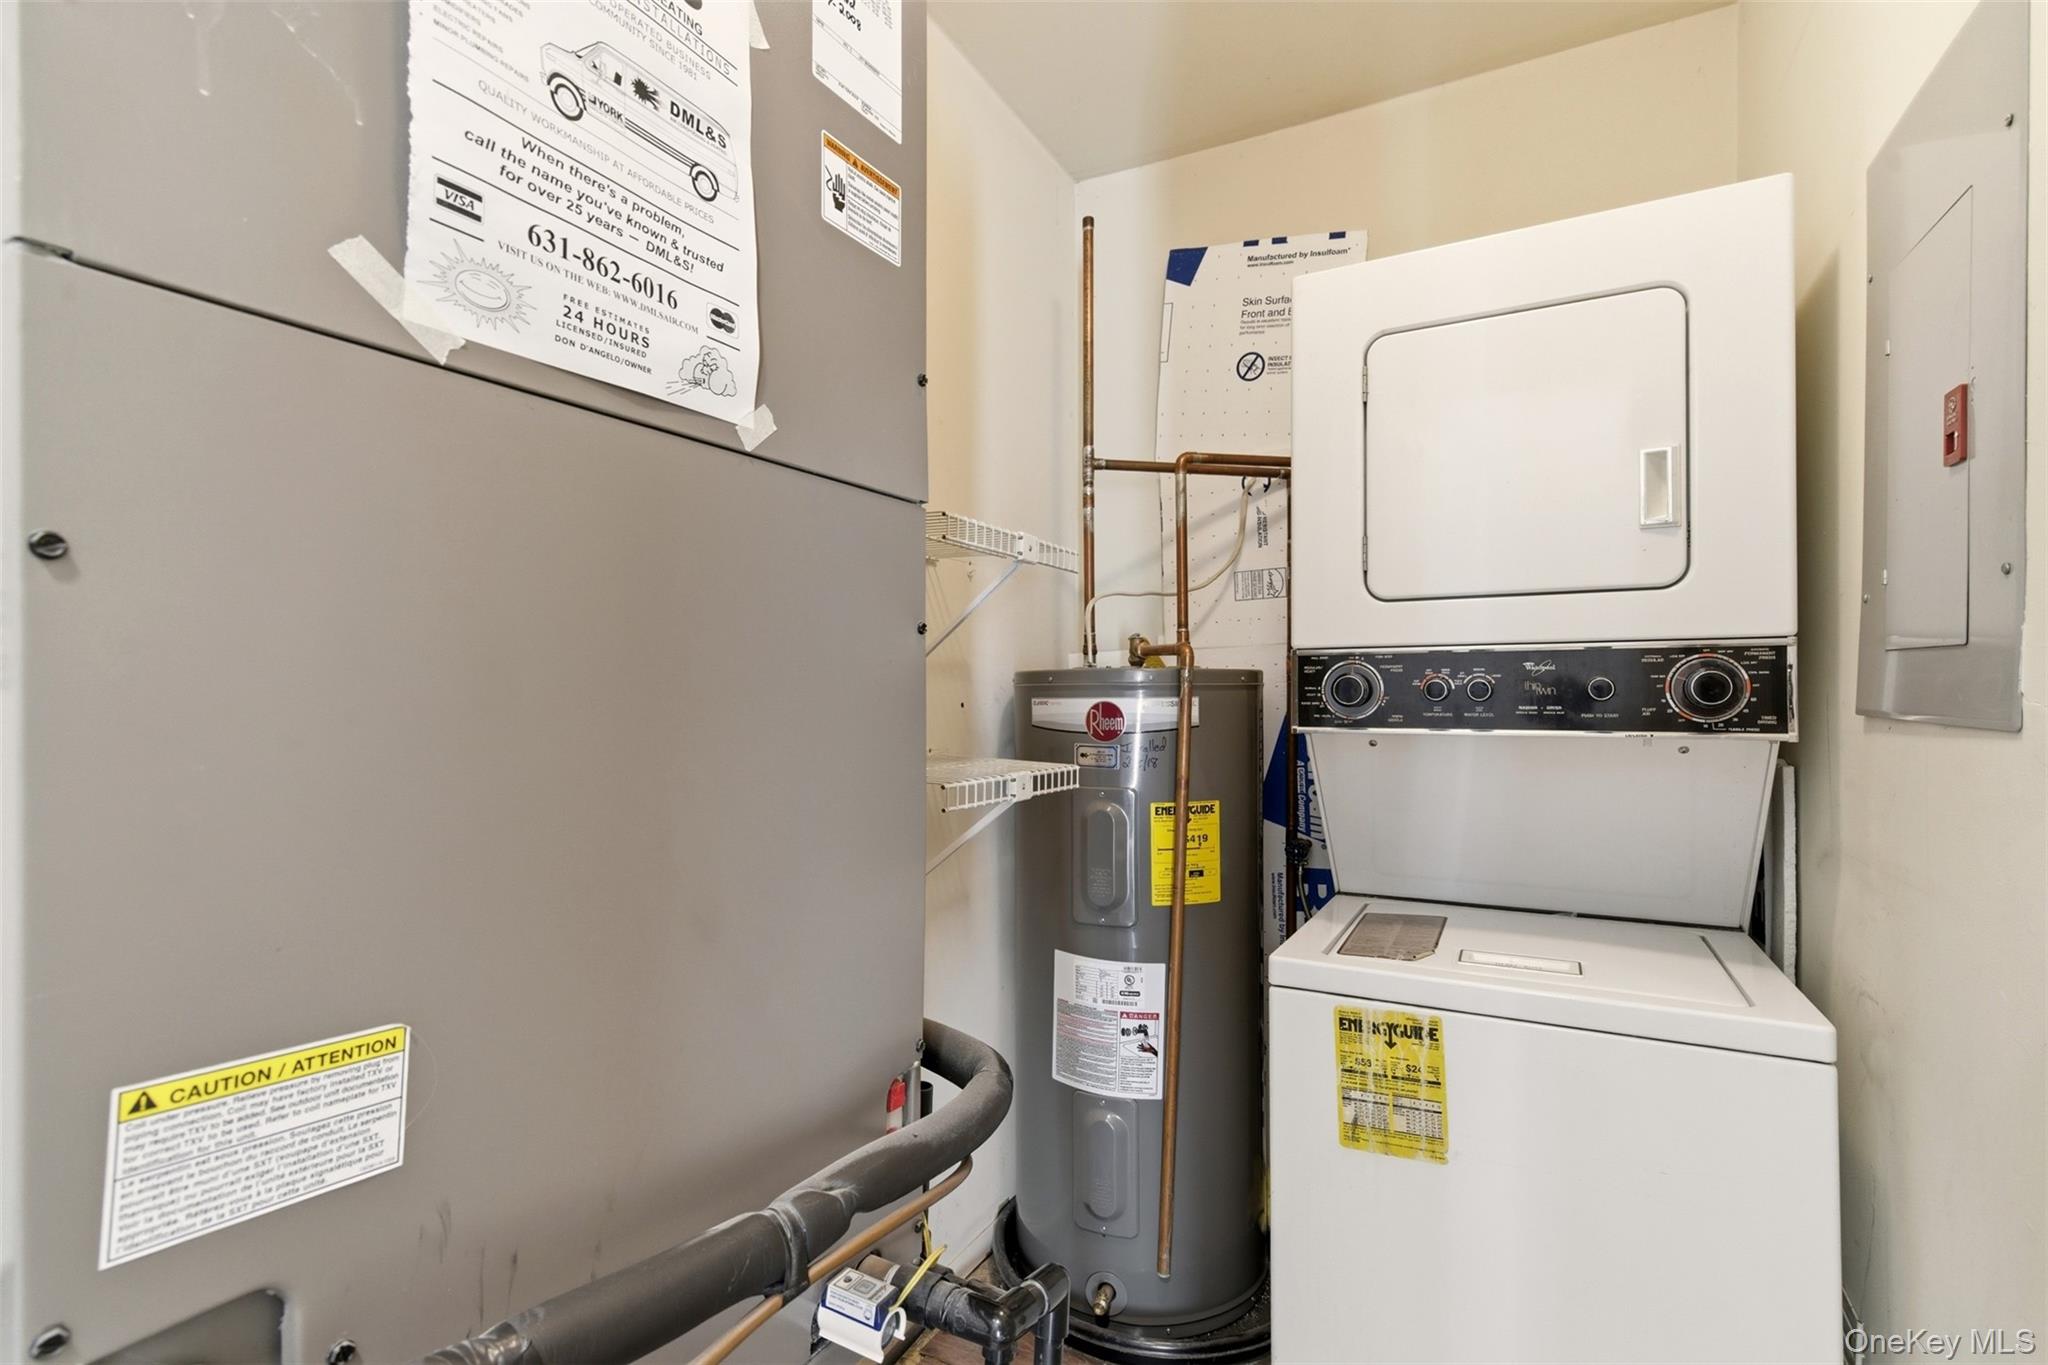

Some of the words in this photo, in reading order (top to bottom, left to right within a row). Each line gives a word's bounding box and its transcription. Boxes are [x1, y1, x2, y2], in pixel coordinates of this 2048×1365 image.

[649, 39, 677, 65] SINCE
[679, 61, 697, 81] 1981
[666, 41, 711, 80] BUSINESS
[599, 100, 624, 123] YORK
[670, 100, 728, 149] DML&S
[478, 79, 528, 115] QUALITY
[531, 112, 611, 164] WORKMANSHIP
[612, 159, 625, 173] AT
[627, 168, 682, 209] AFFORDABLE
[684, 200, 716, 225] PRICES
[444, 188, 476, 211] VISA
[464, 130, 496, 153] call
[500, 146, 527, 169] the
[531, 164, 574, 194] name
[576, 190, 623, 220] you've
[626, 214, 668, 245] known
[670, 238, 680, 250] &
[682, 244, 725, 273] trusted
[521, 137, 565, 171] When
[568, 164, 617, 199] there's
[620, 193, 629, 205] a
[631, 203, 686, 239] problem,
[499, 163, 525, 185] for
[527, 180, 563, 204] over
[565, 199, 583, 216] 25
[586, 211, 625, 239] years
[645, 240, 696, 274] DML&S!
[497, 239, 528, 261] VISIT
[530, 255, 545, 268] US
[545, 261, 561, 274] ON
[562, 268, 585, 285] THE
[586, 278, 611, 295] WEB:
[527, 223, 679, 310] 631-862-6016
[1247, 251, 1298, 262] Manufactured
[1299, 250, 1309, 259] by
[563, 293, 589, 310] FREE
[594, 305, 651, 335] ESTIMATES
[1241, 309, 1266, 319] Front
[1267, 308, 1286, 317] and
[1242, 297, 1263, 307] Skin
[555, 319, 648, 359] LICENSED/INSURED
[562, 305, 584, 323] 24
[593, 318, 651, 349] HOURS
[554, 334, 576, 348] DON
[579, 341, 653, 375] D'ANGELO/OWNER
[1089, 703, 1124, 737] Rheem
[1155, 804, 1215, 816] ENEGUIDE
[1297, 794, 1307, 833] Company
[1276, 872, 1286, 923] Manufactured
[1278, 923, 1286, 934] by
[170, 1066, 271, 1105] CAUTION
[292, 1036, 396, 1074] ATTENTION
